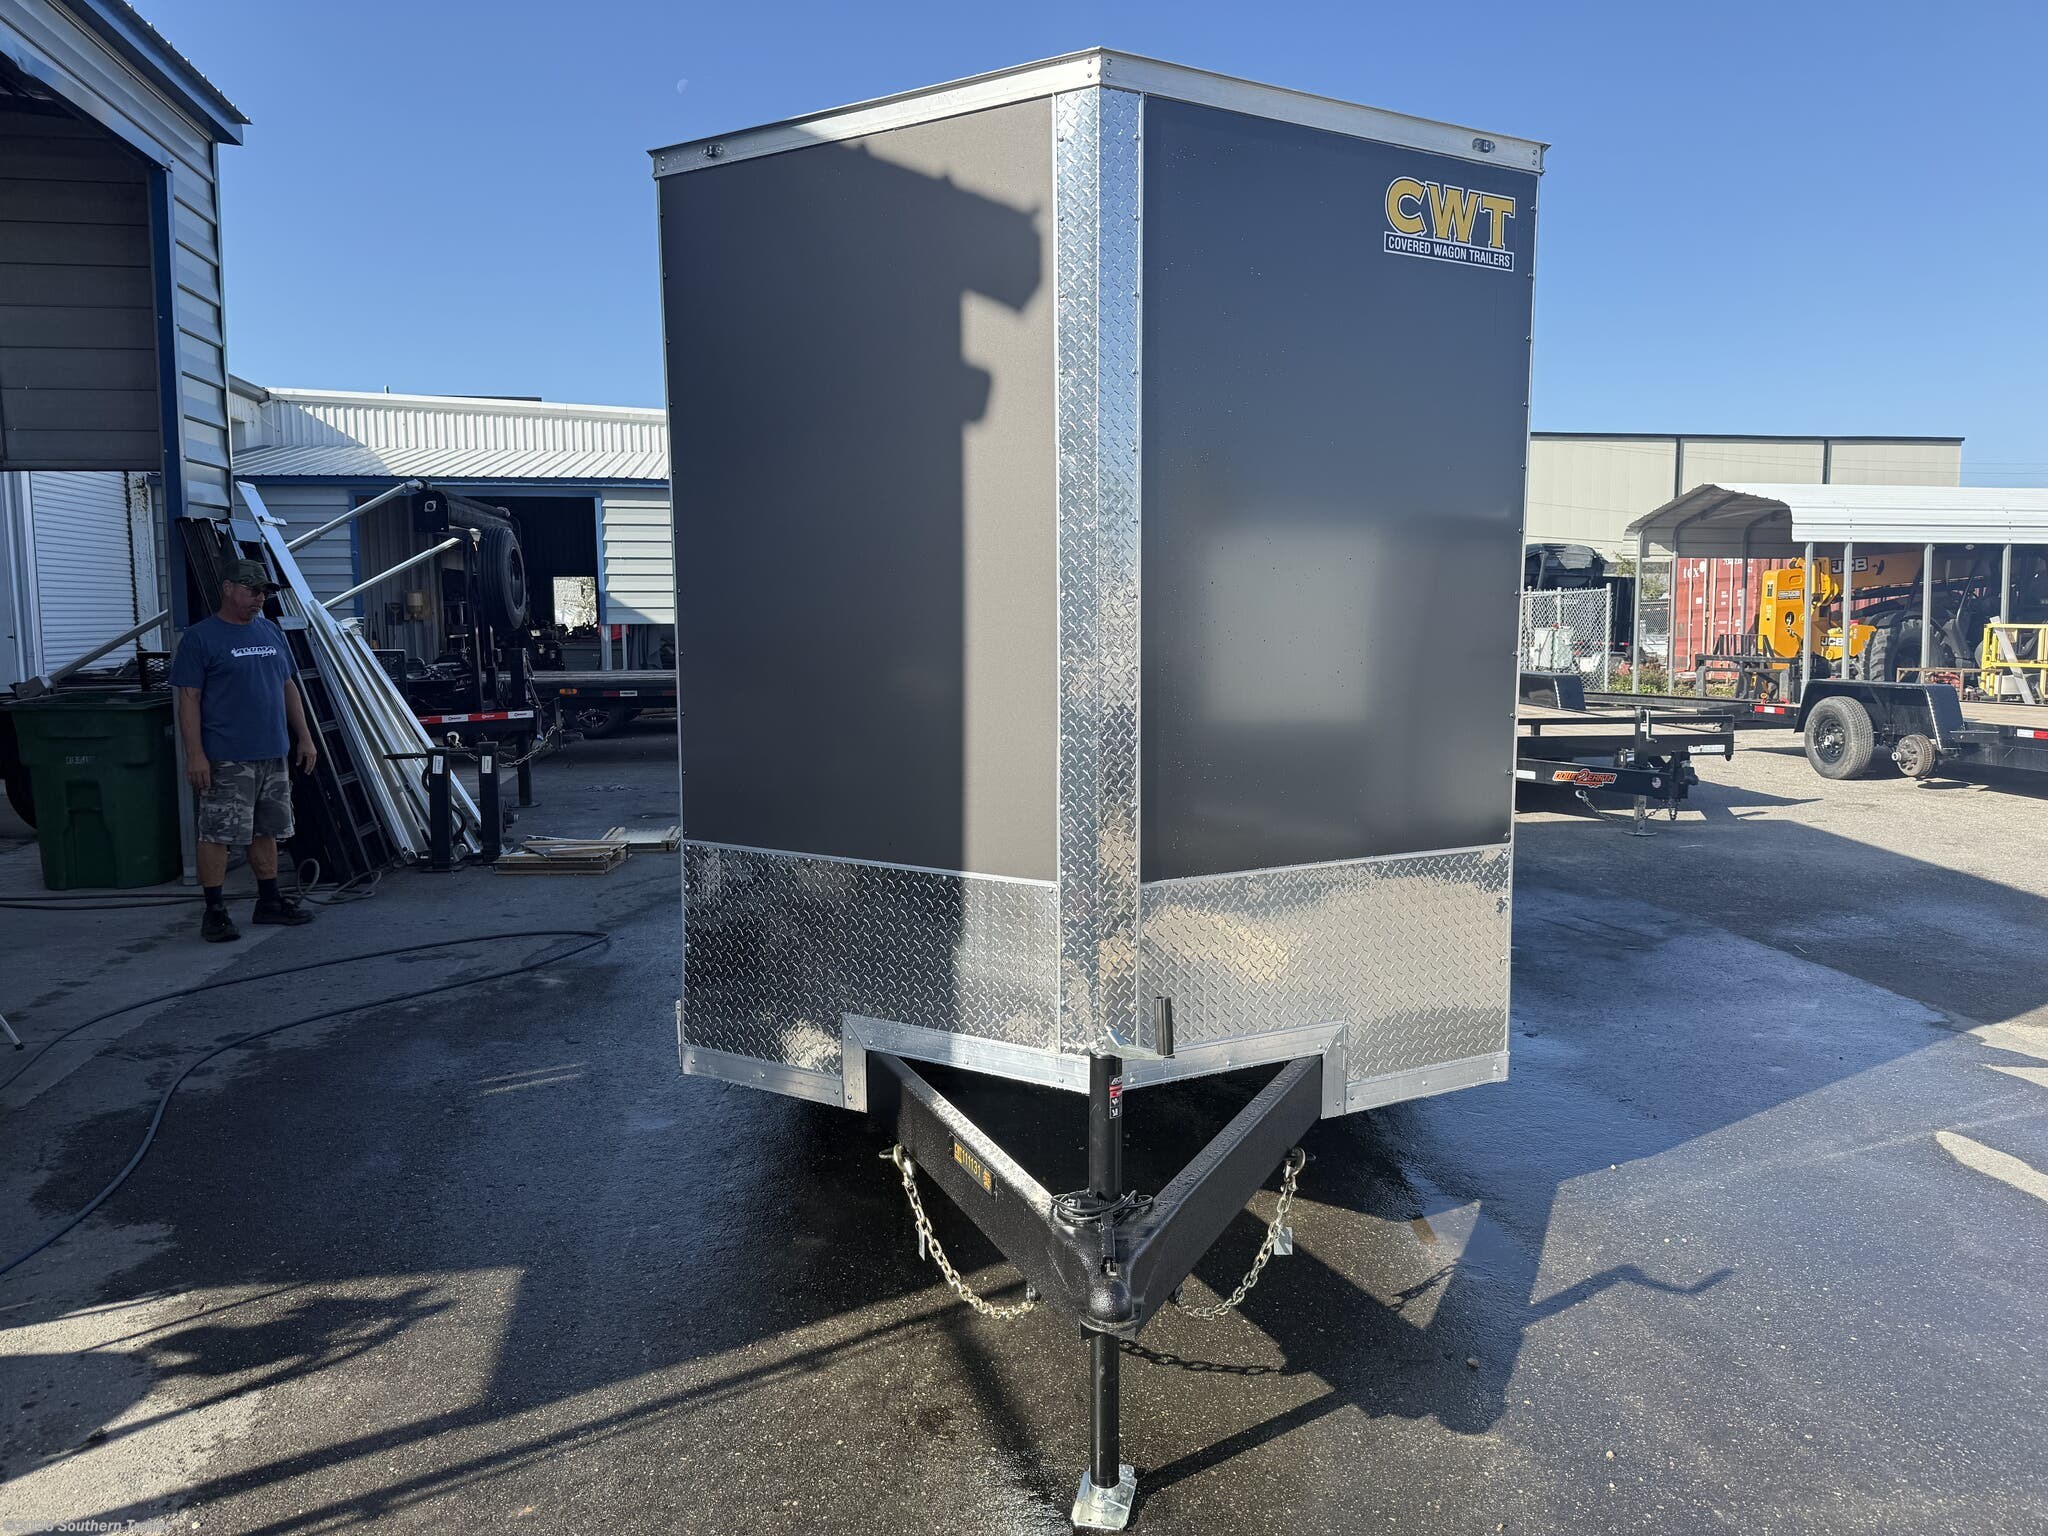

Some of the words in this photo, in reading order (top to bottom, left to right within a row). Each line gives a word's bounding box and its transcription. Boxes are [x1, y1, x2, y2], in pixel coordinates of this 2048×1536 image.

[1386, 177, 1515, 250] CWT
[1388, 236, 1431, 255] COVERED
[1433, 243, 1467, 261] WAGON
[1469, 249, 1511, 268] TRAILERS
